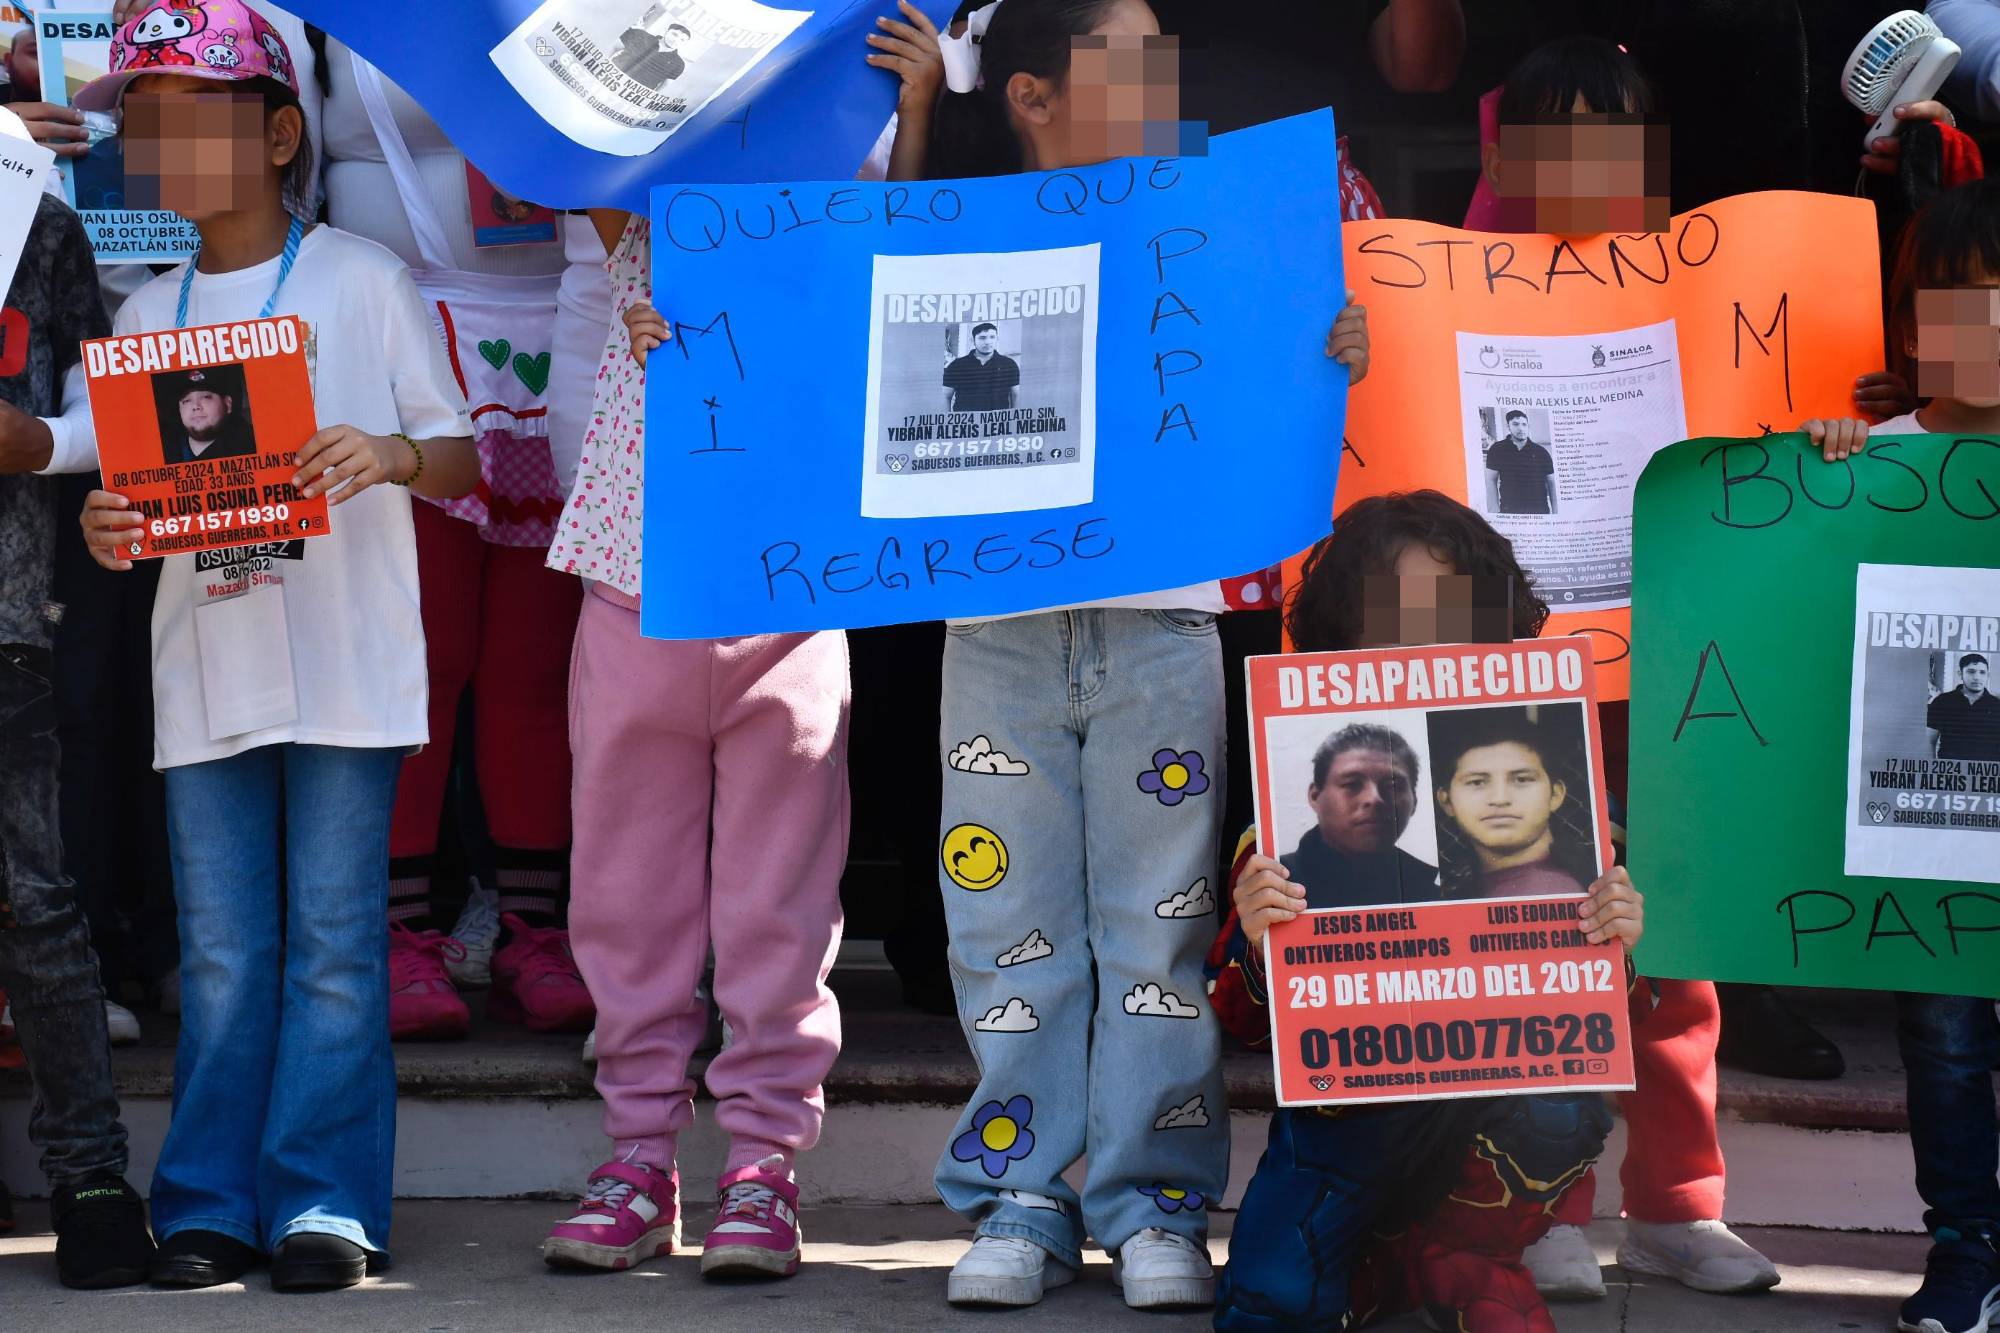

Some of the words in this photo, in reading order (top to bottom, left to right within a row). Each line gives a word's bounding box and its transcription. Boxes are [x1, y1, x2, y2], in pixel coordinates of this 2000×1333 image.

[551, 21, 588, 61] YIBRAN
[584, 60, 621, 92] ALEXIS
[618, 87, 643, 107] LEAL
[600, 58, 624, 81] 2024
[549, 59, 589, 98] SABUESOS
[1037, 158, 1181, 215] QUE
[111, 213, 144, 224] LUIS
[98, 227, 115, 239] 08
[118, 226, 185, 238] OCTUBRE
[888, 286, 1081, 323] DESAPARECIDO
[86, 319, 298, 378] DESAPARECIDO
[1609, 344, 1653, 358] SINALOA
[1503, 358, 1543, 370] Sinaloa
[1571, 374, 1642, 391] encontrar
[1496, 396, 1532, 407] YIBRAN
[1536, 396, 1570, 407] ALEXIS
[1572, 396, 1597, 406] LEAL
[1600, 389, 1644, 404] MEDINA
[903, 416, 915, 428] 17
[918, 414, 945, 426] JULIO
[947, 412, 975, 426] 2024
[980, 408, 1033, 424] NAVOLATO
[1037, 406, 1058, 418] SIN.
[888, 426, 933, 442] YIBRAN
[936, 424, 980, 440] ALEXIS
[983, 421, 1013, 437] LEAL
[1016, 417, 1066, 434] MEDINA
[914, 442, 954, 458] 667
[957, 440, 992, 456] 157
[996, 435, 1044, 453] 1930
[911, 456, 961, 471] SABUESOS
[964, 452, 1024, 469] GUERRERAS,
[1026, 451, 1046, 464] A.C.
[113, 473, 128, 487] 08
[131, 466, 181, 485] OCTUBRE
[185, 462, 214, 479] 2024
[175, 478, 206, 493] EDAD:
[210, 476, 224, 489] 33
[168, 496, 203, 516] LUIS
[207, 486, 259, 511] OSUNA
[151, 516, 192, 536] 667
[196, 511, 233, 531] 157
[238, 504, 289, 525] 1930
[150, 534, 205, 552] SABUESOS
[208, 526, 270, 543] GUERRERAS,
[273, 522, 294, 537] A.C.
[761, 518, 1114, 604] REGRESE
[1278, 648, 1583, 709] DESAPARECIDO
[1673, 640, 1770, 746] A
[1886, 759, 1898, 772] 17
[1900, 759, 1929, 773] JULIO
[1931, 761, 1961, 775] 2024
[1870, 770, 1916, 789] YIBRAN
[1920, 773, 1967, 792] ALEXIS
[1896, 792, 1938, 810] 667
[1941, 794, 1981, 812] 157
[1893, 810, 1947, 825] SABUESOS
[1949, 812, 2000, 828] GUERRER
[1313, 914, 1361, 935] JESUS
[1365, 911, 1417, 932] ANGEL
[1488, 905, 1519, 925] LUIS
[1284, 942, 1377, 965] ONTIVEROS
[1380, 937, 1451, 960] CAMPOS
[1470, 931, 1548, 953] ONTIVEROS
[1289, 975, 1327, 1009] 29
[1334, 972, 1370, 1006] DE
[1376, 966, 1475, 1003] MARZO
[1485, 963, 1535, 997] DEL
[1541, 959, 1614, 994] 2012
[1300, 1012, 1615, 1070] 01800077628
[1344, 1070, 1426, 1088] SABUESOS
[1430, 1065, 1525, 1084] GUERRERAS,
[1528, 1064, 1558, 1078] A.C.
[75, 1188, 125, 1200] SPORTLINE
